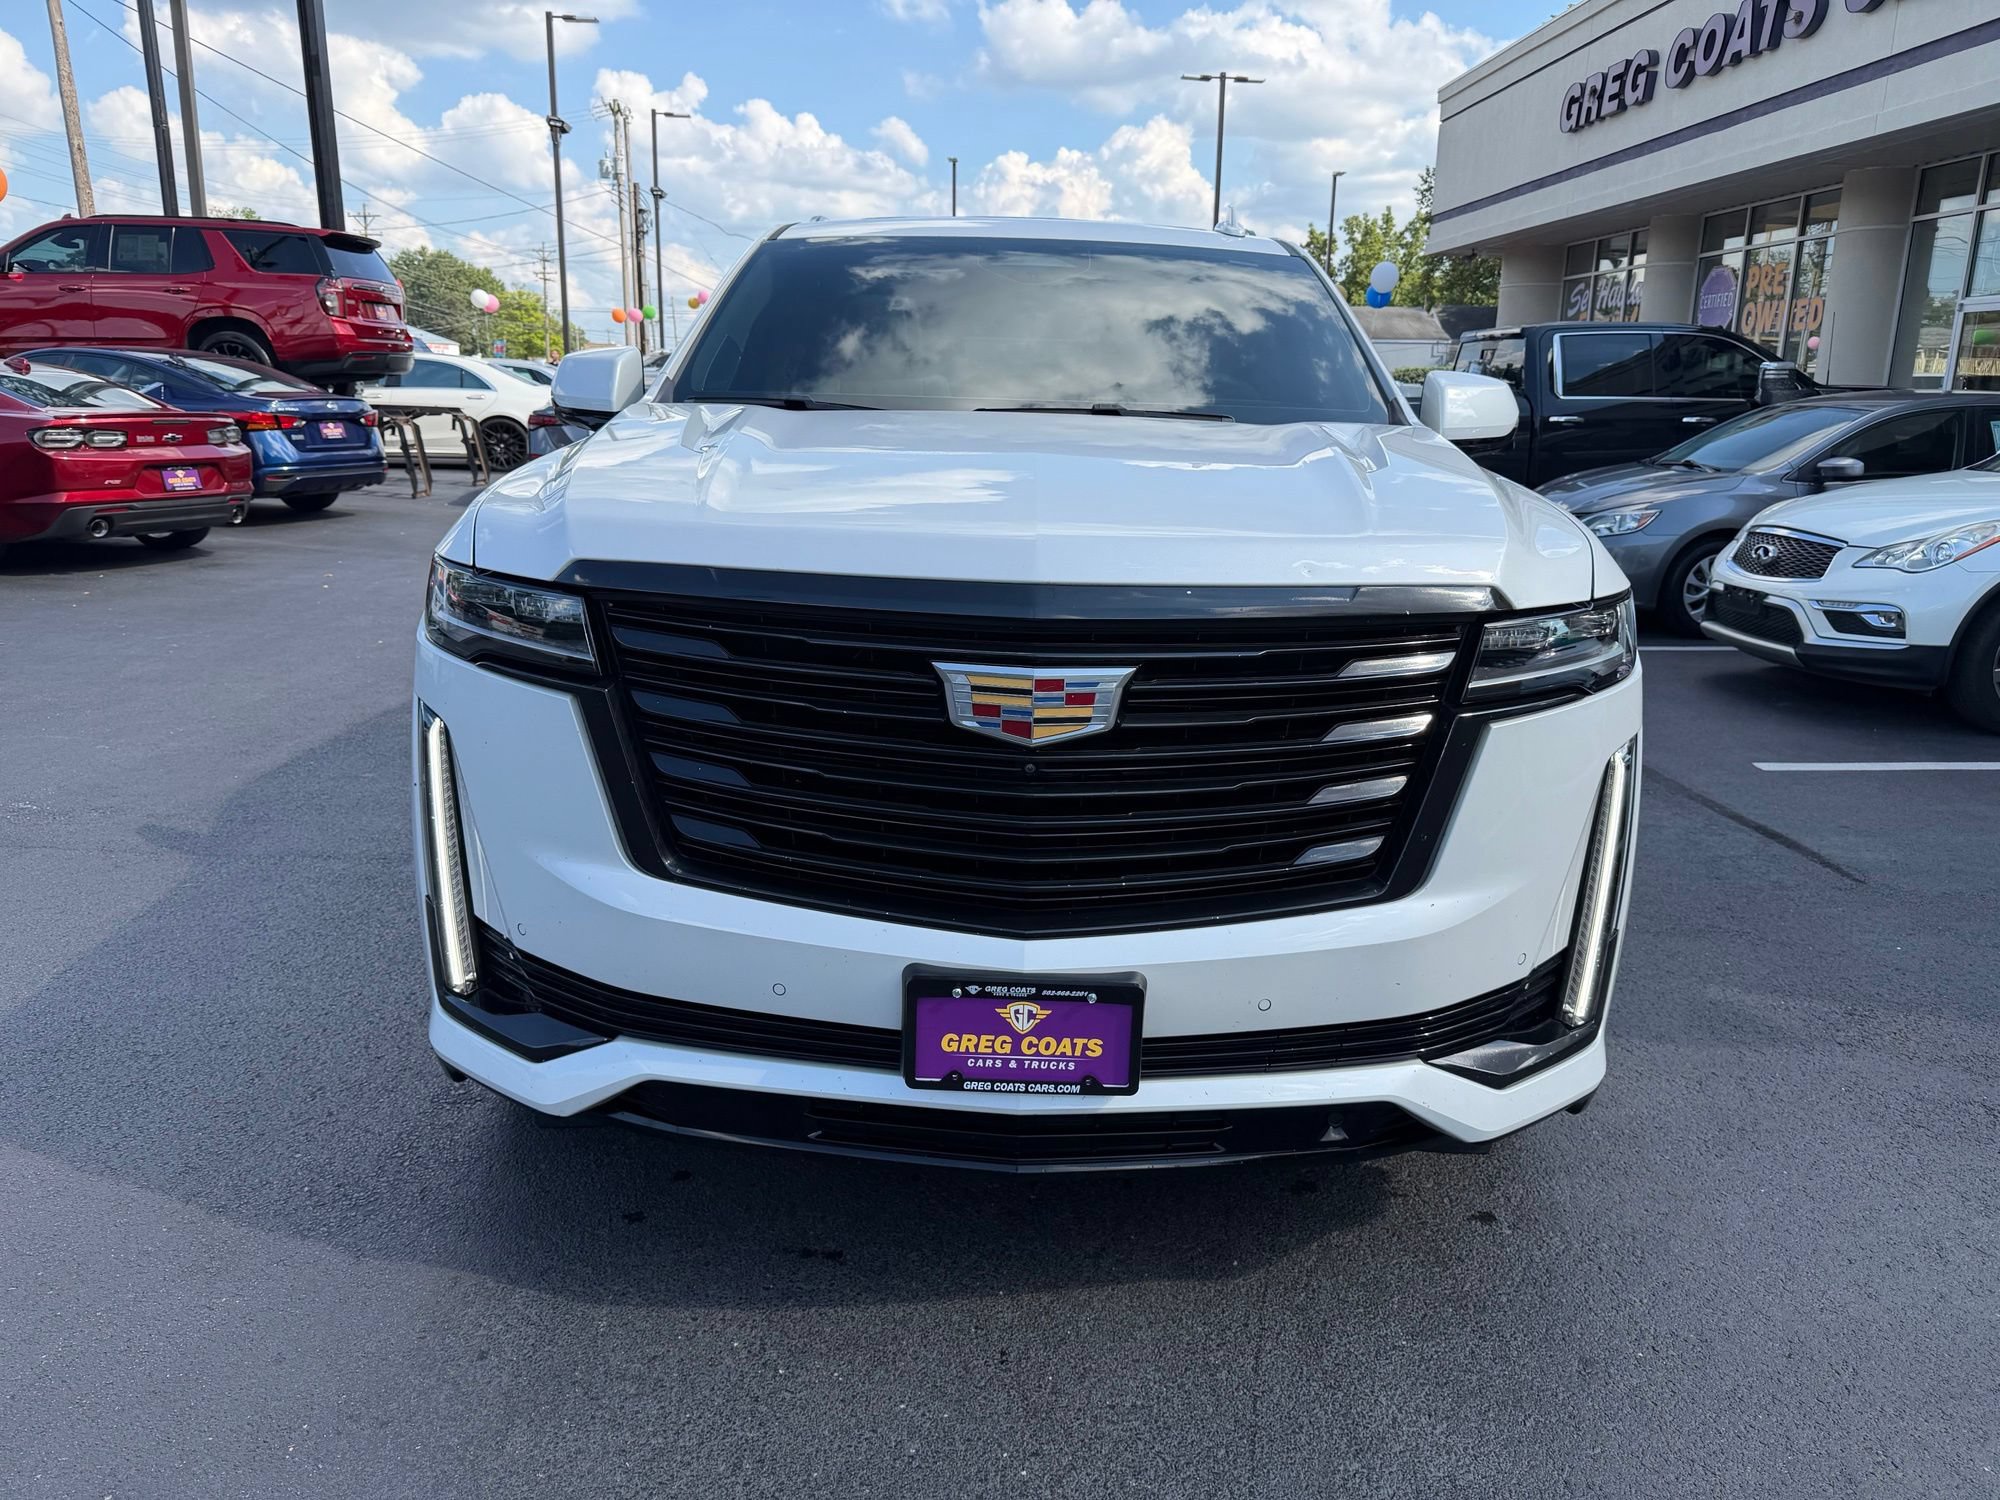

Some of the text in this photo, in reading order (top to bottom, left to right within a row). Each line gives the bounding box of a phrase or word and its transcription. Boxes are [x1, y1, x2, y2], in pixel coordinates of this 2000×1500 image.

[1560, 0, 1828, 133] GREG COATS
[1746, 261, 1790, 298] PRE
[1700, 292, 1734, 309] CERTIFIED
[985, 985, 1008, 993] GREG
[1010, 986, 1036, 994] COATS
[941, 1033, 1104, 1057] GREG COATS
[967, 1058, 1076, 1070] CARS & TRUCKS
[963, 1081, 1081, 1094] GREG COATS CARS.COM
